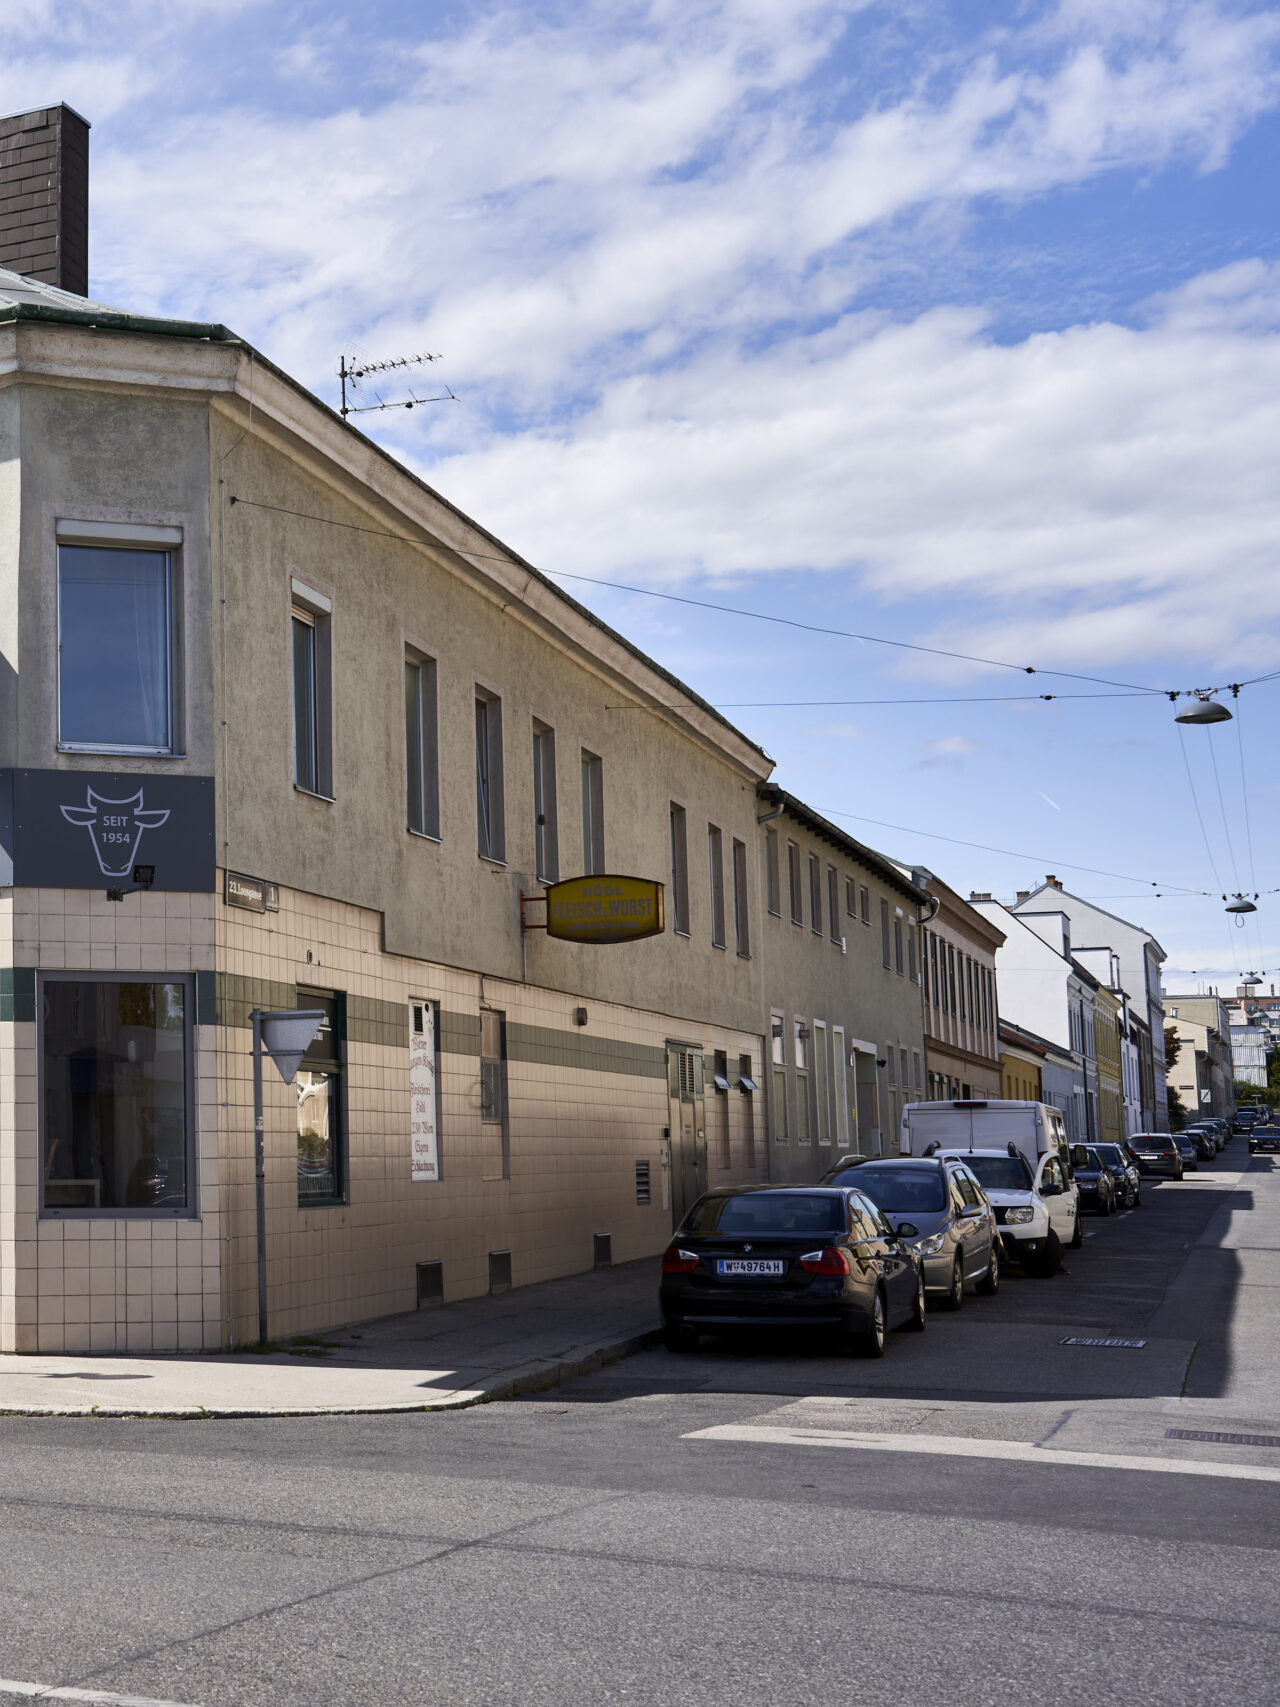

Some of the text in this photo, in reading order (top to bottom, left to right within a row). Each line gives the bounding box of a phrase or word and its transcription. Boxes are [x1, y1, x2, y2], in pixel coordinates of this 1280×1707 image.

[103, 815, 128, 827] SEIT
[102, 832, 130, 844] 1954
[583, 884, 624, 896] HÖDL
[553, 901, 602, 919] FLEISCH
[609, 898, 653, 917] WURST
